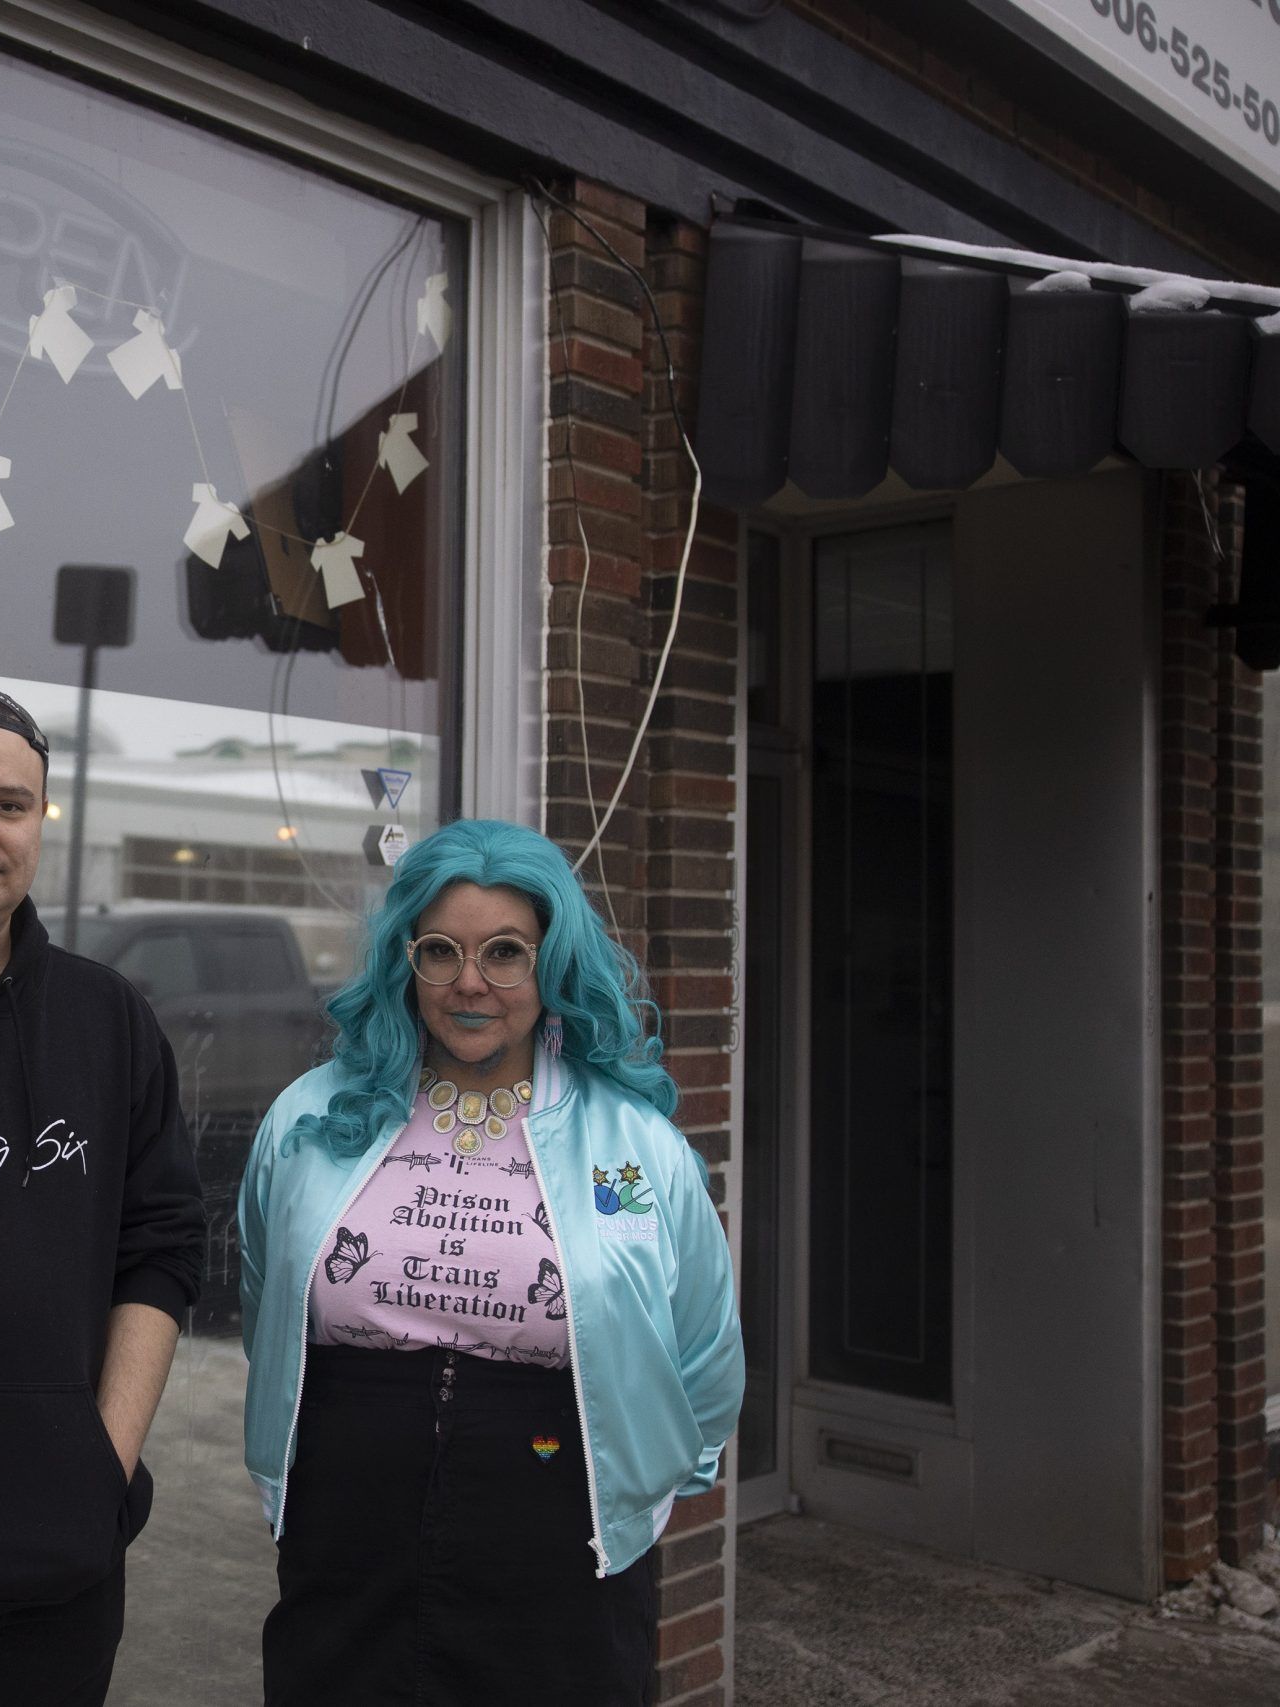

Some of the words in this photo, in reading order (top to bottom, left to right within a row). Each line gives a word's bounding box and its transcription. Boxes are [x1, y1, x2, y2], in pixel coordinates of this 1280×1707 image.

[32, 1118, 88, 1176] Six
[410, 1184, 511, 1213] Prison
[390, 1205, 524, 1236] Abolition
[439, 1233, 467, 1257] is
[402, 1255, 501, 1290] Trans
[369, 1280, 528, 1323] Liberation
